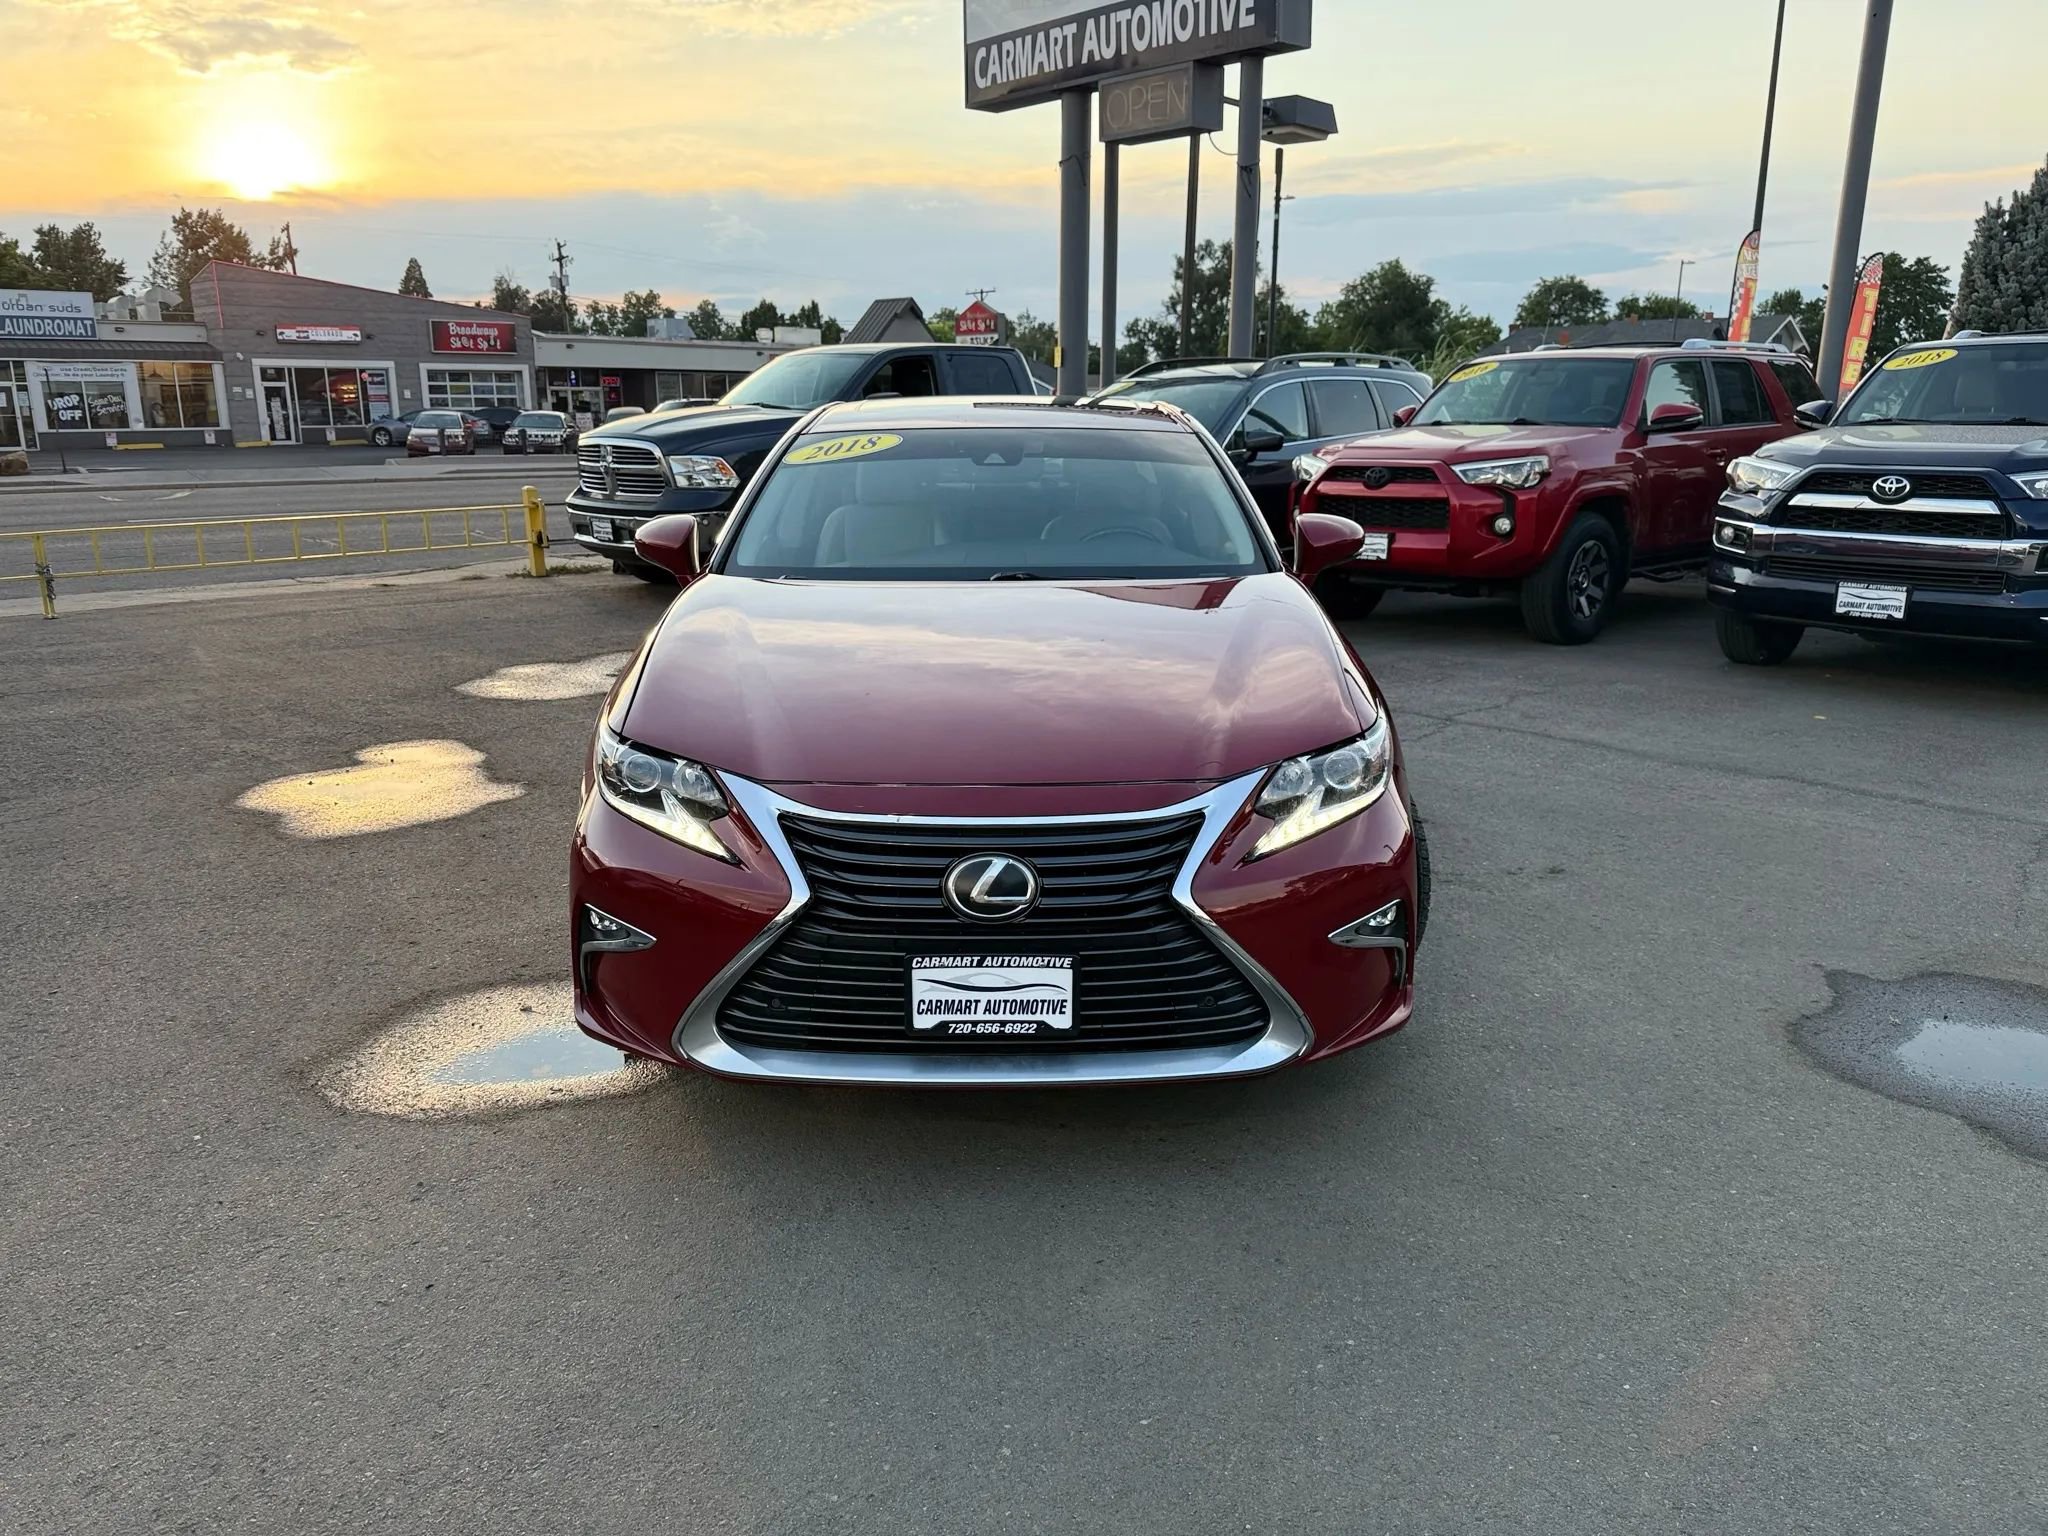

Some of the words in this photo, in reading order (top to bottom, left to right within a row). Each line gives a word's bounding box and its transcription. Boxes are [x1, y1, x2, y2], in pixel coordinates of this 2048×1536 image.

[974, 22, 1077, 90] CARMART
[1081, 0, 1257, 65] AUTOMOTIVE
[1106, 78, 1188, 128] OPEN
[48, 304, 82, 313] suds
[448, 322, 499, 337] Broadways
[1896, 350, 1946, 368] 2018
[58, 409, 83, 421] OFF
[802, 435, 882, 461] 2018
[1838, 600, 1866, 609] CARMART
[1866, 602, 1903, 613] AUTOMOTIVE
[912, 956, 981, 968] CARMART
[983, 956, 1073, 968] AUTOMOTIVE
[916, 998, 981, 1016] CARMART
[982, 998, 1067, 1016] AUTOMOTIVE
[948, 1023, 1037, 1034] 720-656-6922
